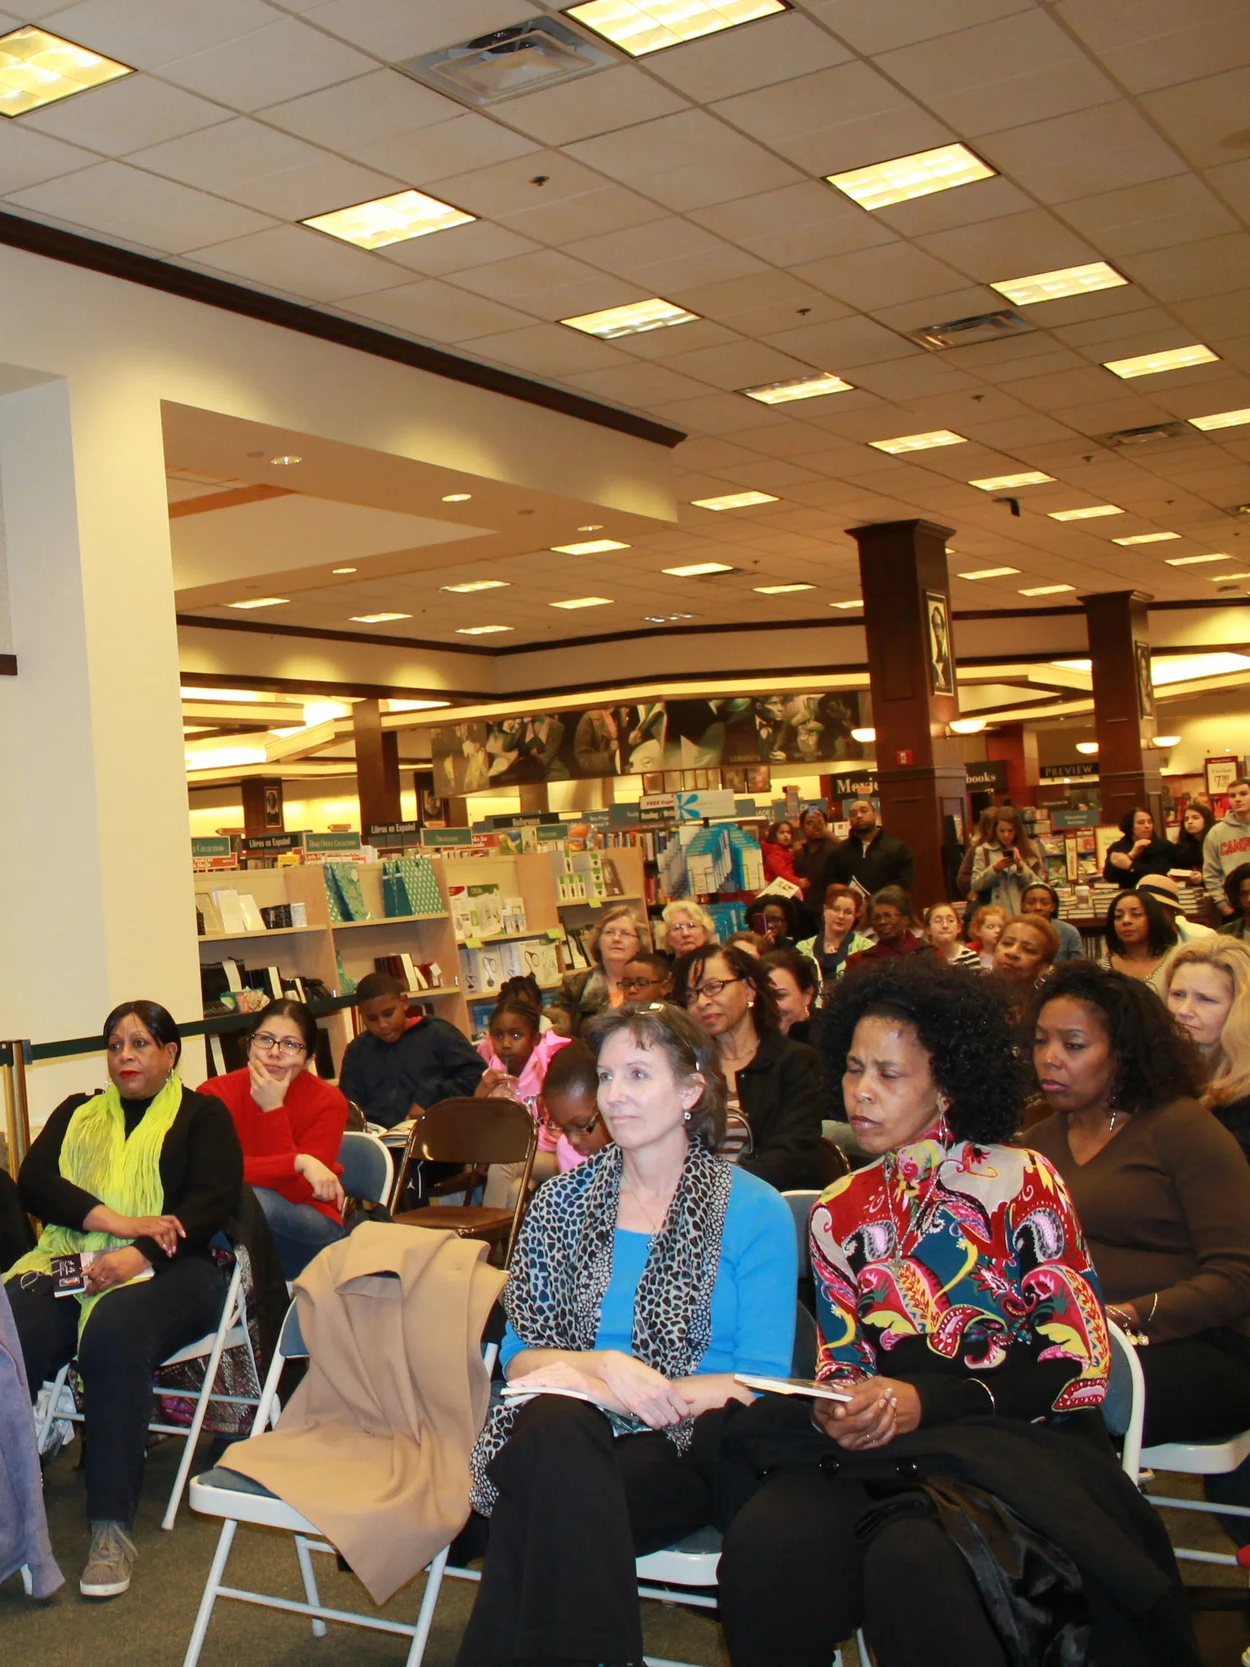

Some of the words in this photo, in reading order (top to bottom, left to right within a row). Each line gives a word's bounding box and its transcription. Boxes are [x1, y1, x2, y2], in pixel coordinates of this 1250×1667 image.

[1045, 764, 1093, 777] PREVIEW
[371, 824, 388, 834] Libros
[249, 838, 265, 848] Libros
